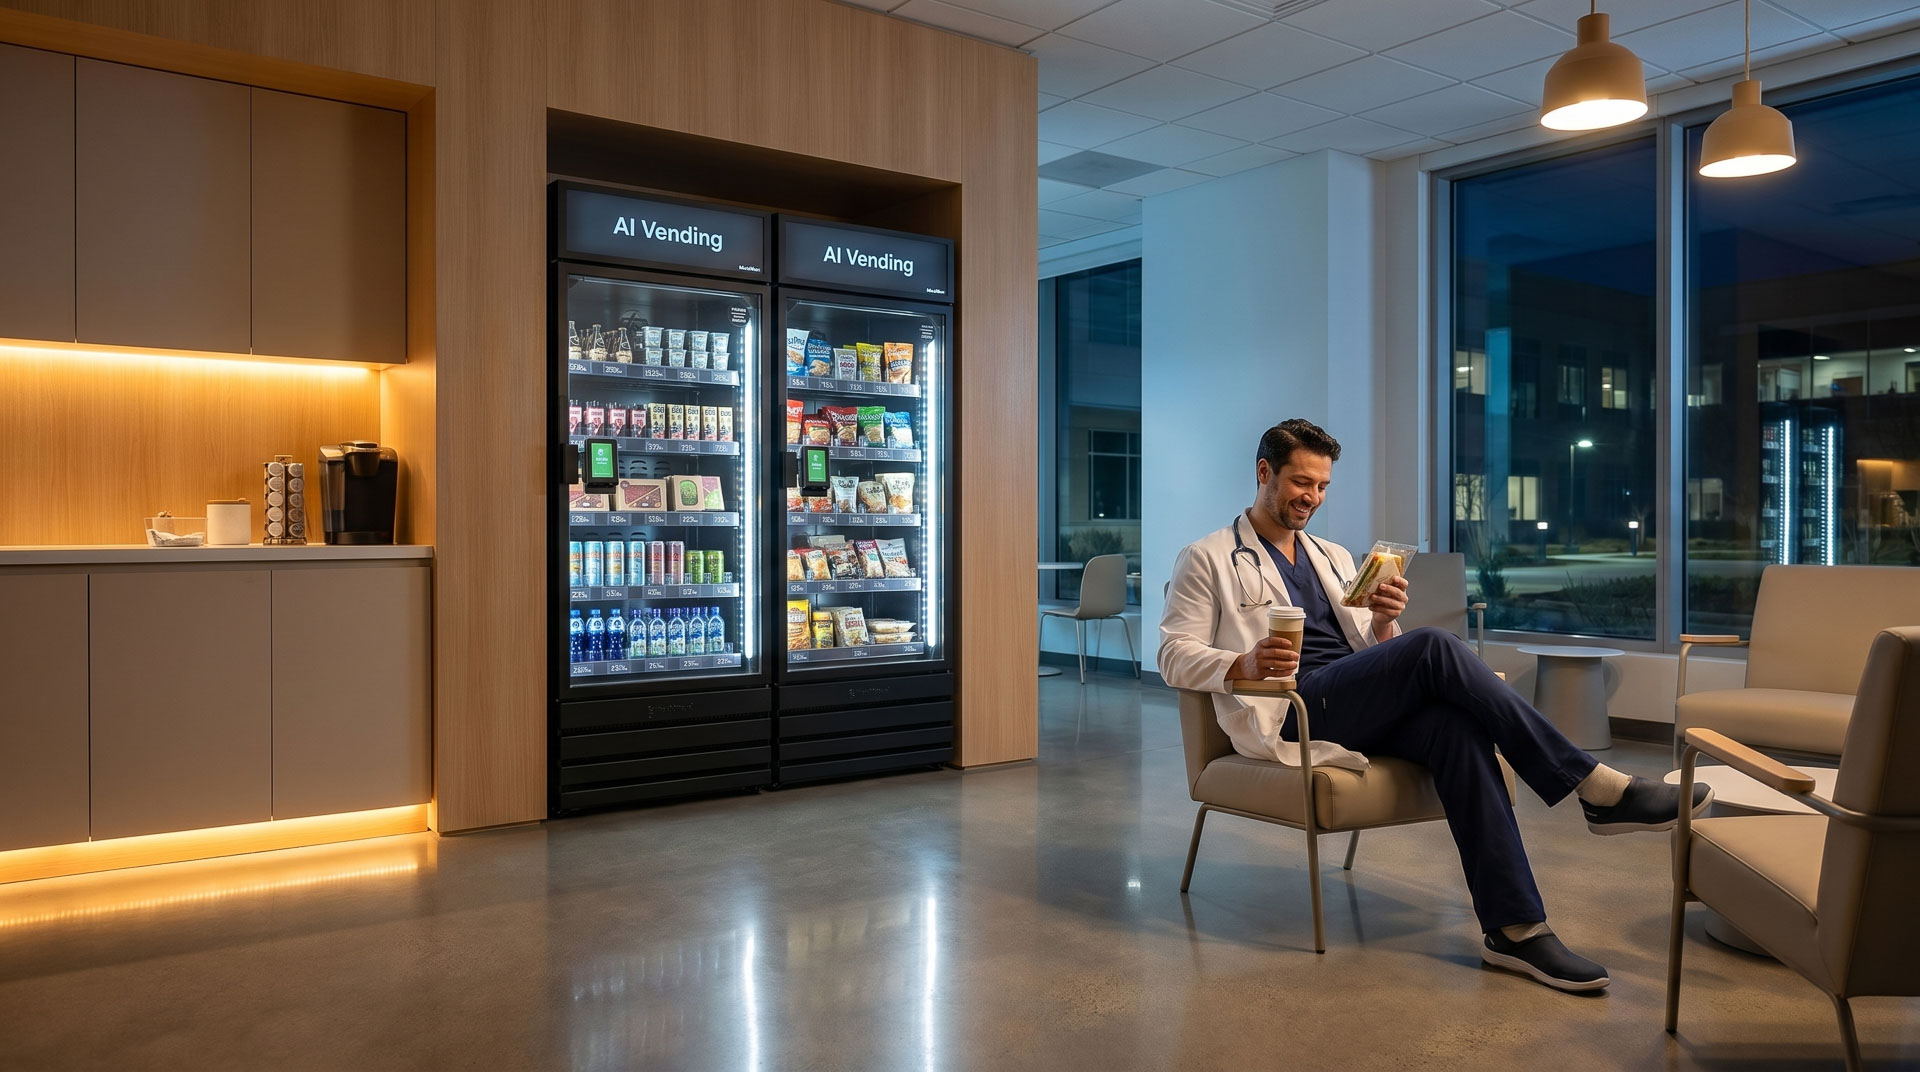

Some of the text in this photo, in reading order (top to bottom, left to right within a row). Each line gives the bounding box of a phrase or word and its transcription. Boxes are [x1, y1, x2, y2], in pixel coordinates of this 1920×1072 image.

[612, 216, 722, 252] AI Vending
[823, 245, 913, 276] AI Vending
